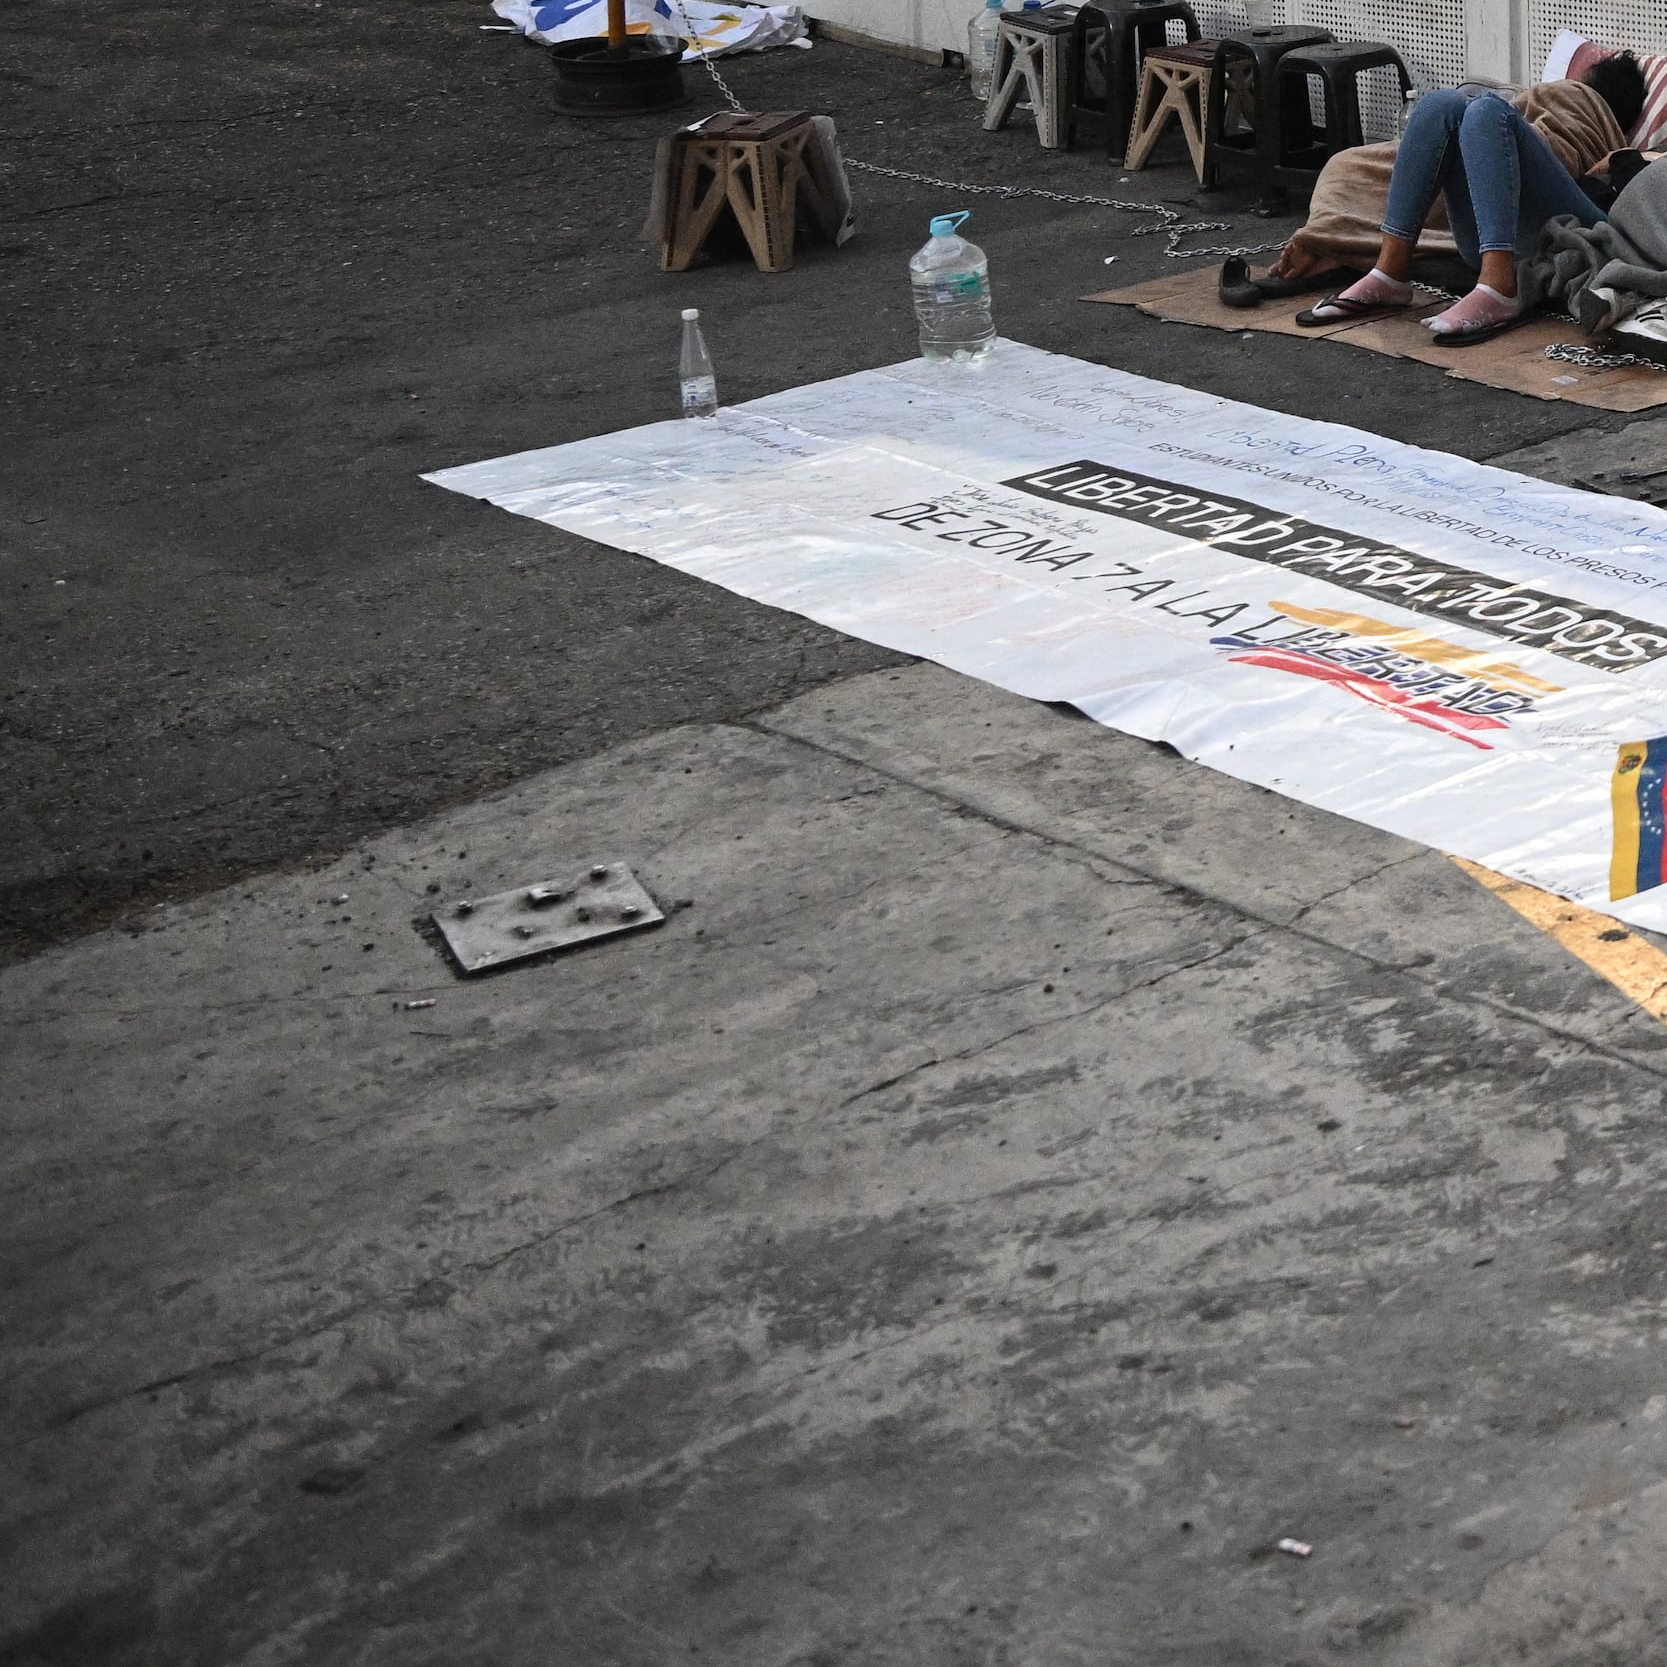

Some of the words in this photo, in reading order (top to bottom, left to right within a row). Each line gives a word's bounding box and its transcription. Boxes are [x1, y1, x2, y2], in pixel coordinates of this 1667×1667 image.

[871, 501, 970, 531] DE
[1023, 465, 1294, 547] LIBERTAD
[1267, 533, 1447, 598] PARA
[1148, 442, 1269, 473] ESTUDIANTES
[1264, 466, 1337, 492] UNIDOS
[1334, 487, 1379, 507] POR
[1375, 501, 1401, 513] LA
[1400, 506, 1496, 539] LIBERTAD
[1490, 535, 1528, 548] DE
[1521, 543, 1569, 559] LOS
[1564, 556, 1656, 585] PRESOS
[935, 521, 1098, 571] ZONA
[1070, 563, 1148, 580] 7
[1104, 578, 1177, 602] A
[1154, 590, 1251, 628] LA
[1233, 615, 1537, 717] LIBERTAD
